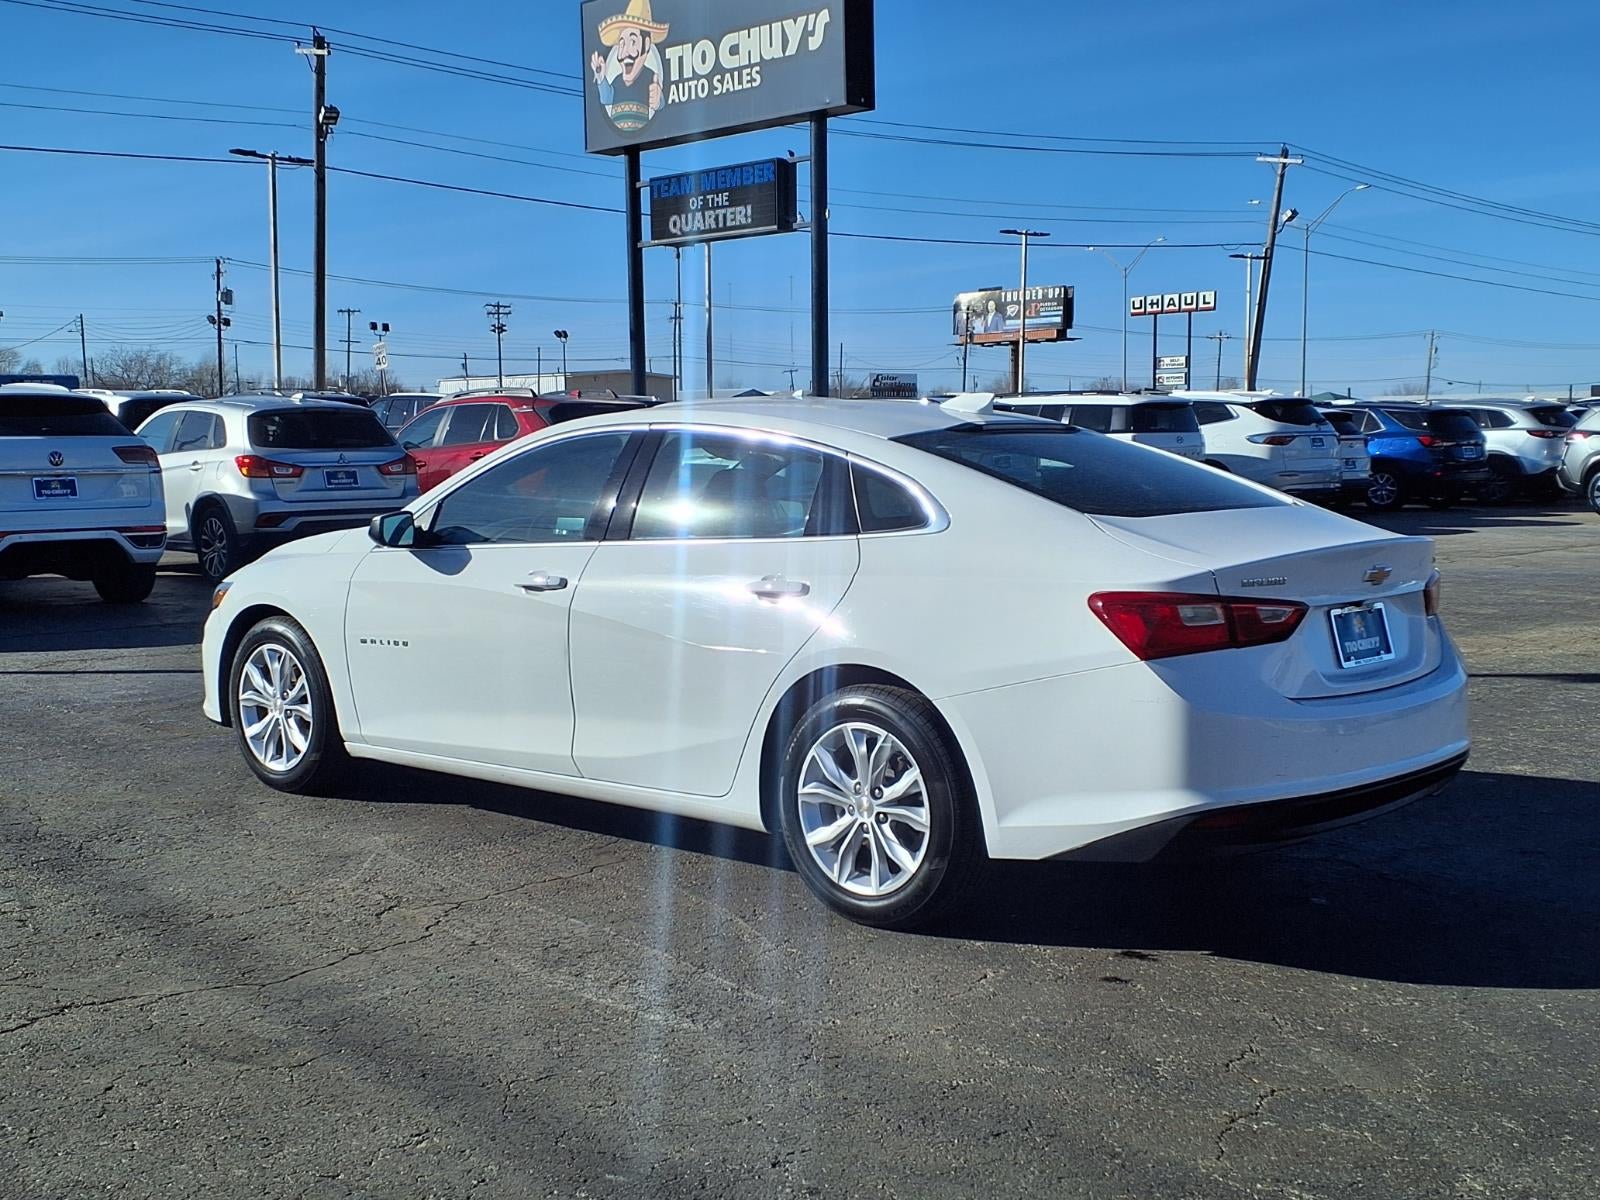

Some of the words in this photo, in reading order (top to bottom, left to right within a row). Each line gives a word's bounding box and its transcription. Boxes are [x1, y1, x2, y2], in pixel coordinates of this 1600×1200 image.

[665, 39, 716, 82] TIO
[718, 8, 830, 69] CHUY'S
[667, 78, 709, 105] AUTO
[713, 66, 762, 96] SALES
[652, 174, 696, 198] TEAM
[701, 162, 775, 191] MEMBER
[689, 195, 704, 210] OF
[706, 192, 729, 208] THE
[668, 204, 752, 236] QUARTER!
[375, 355, 387, 366] 40
